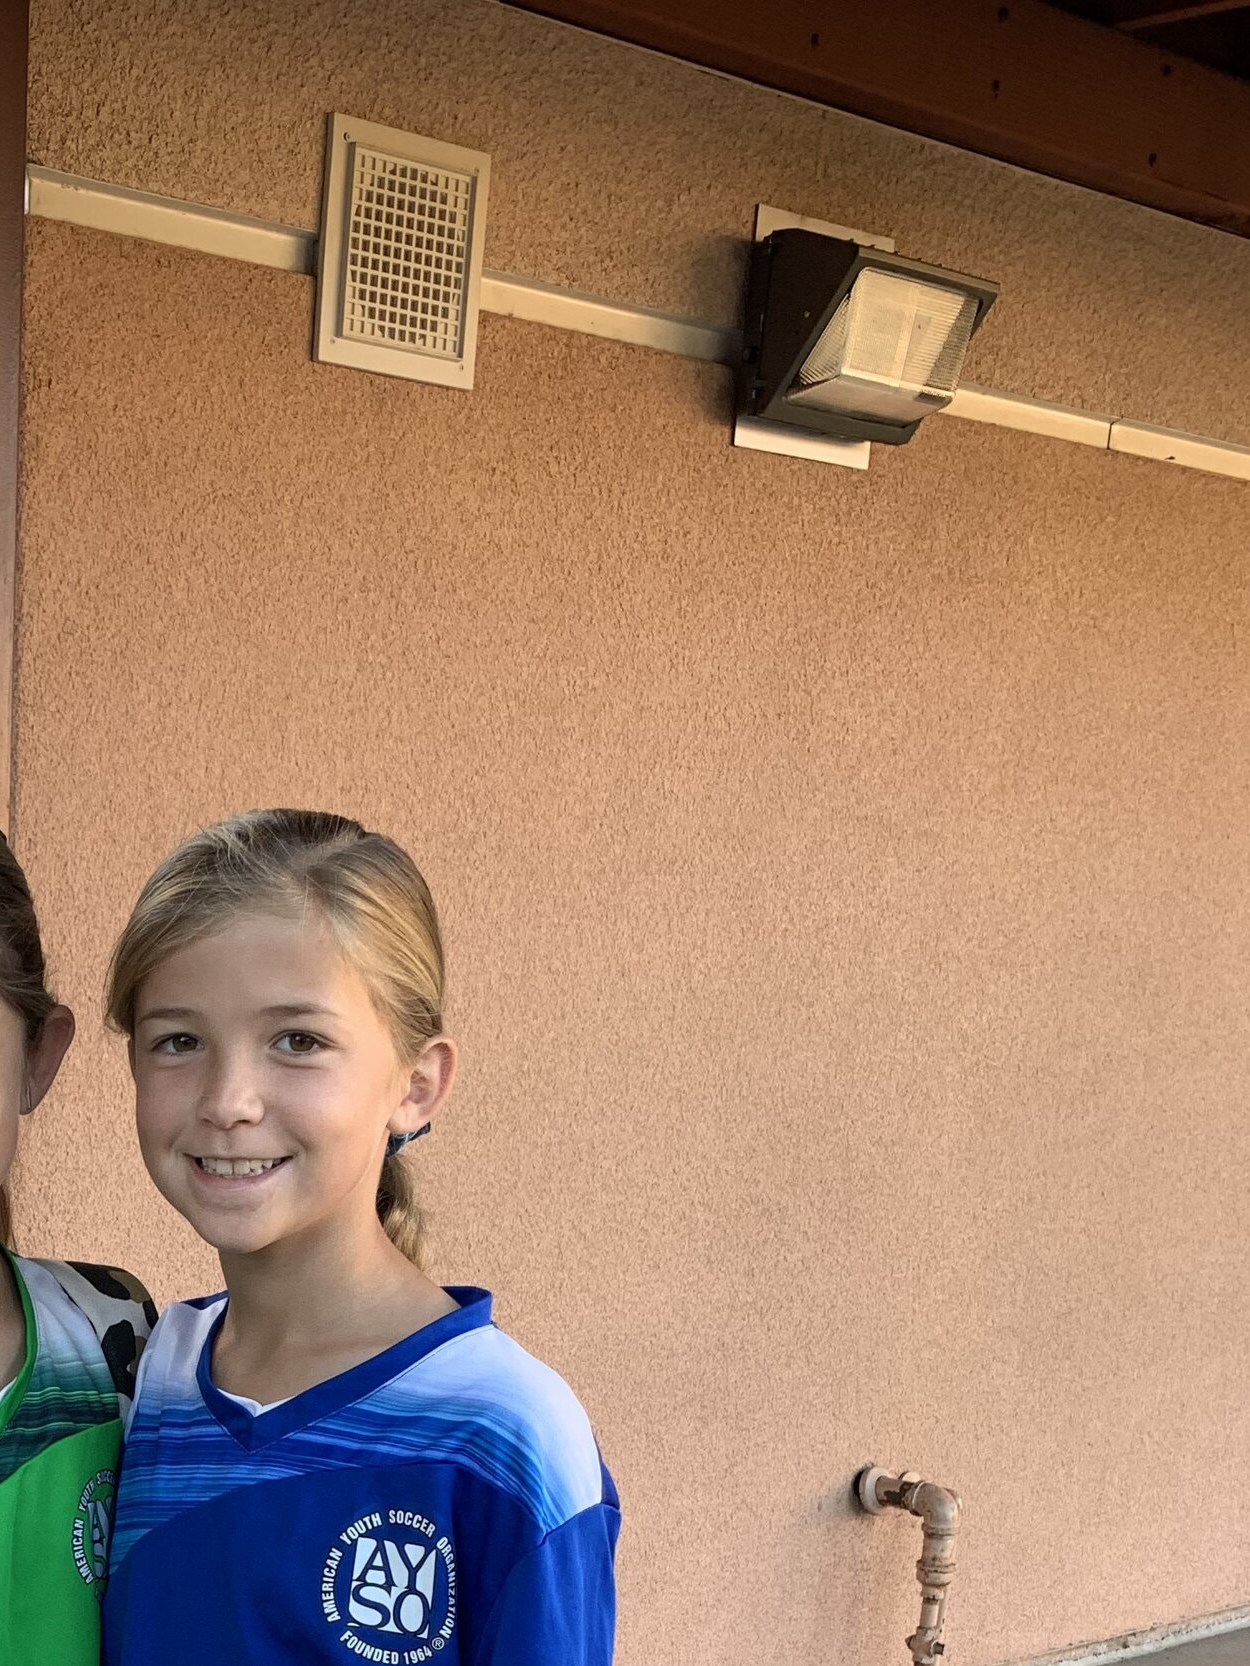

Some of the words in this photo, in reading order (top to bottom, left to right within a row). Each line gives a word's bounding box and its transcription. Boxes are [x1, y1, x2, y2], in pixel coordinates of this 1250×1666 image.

[78, 1479, 95, 1512] YOUTH
[72, 1518, 94, 1584] AMERICAN
[321, 1547, 343, 1623] AMERICAN
[339, 1512, 383, 1546] YOUTH
[388, 1509, 436, 1538] SOCCER
[436, 1536, 456, 1639] ORGANIZATION
[339, 1630, 399, 1665] FOUNDED
[403, 1645, 433, 1665] 1964
